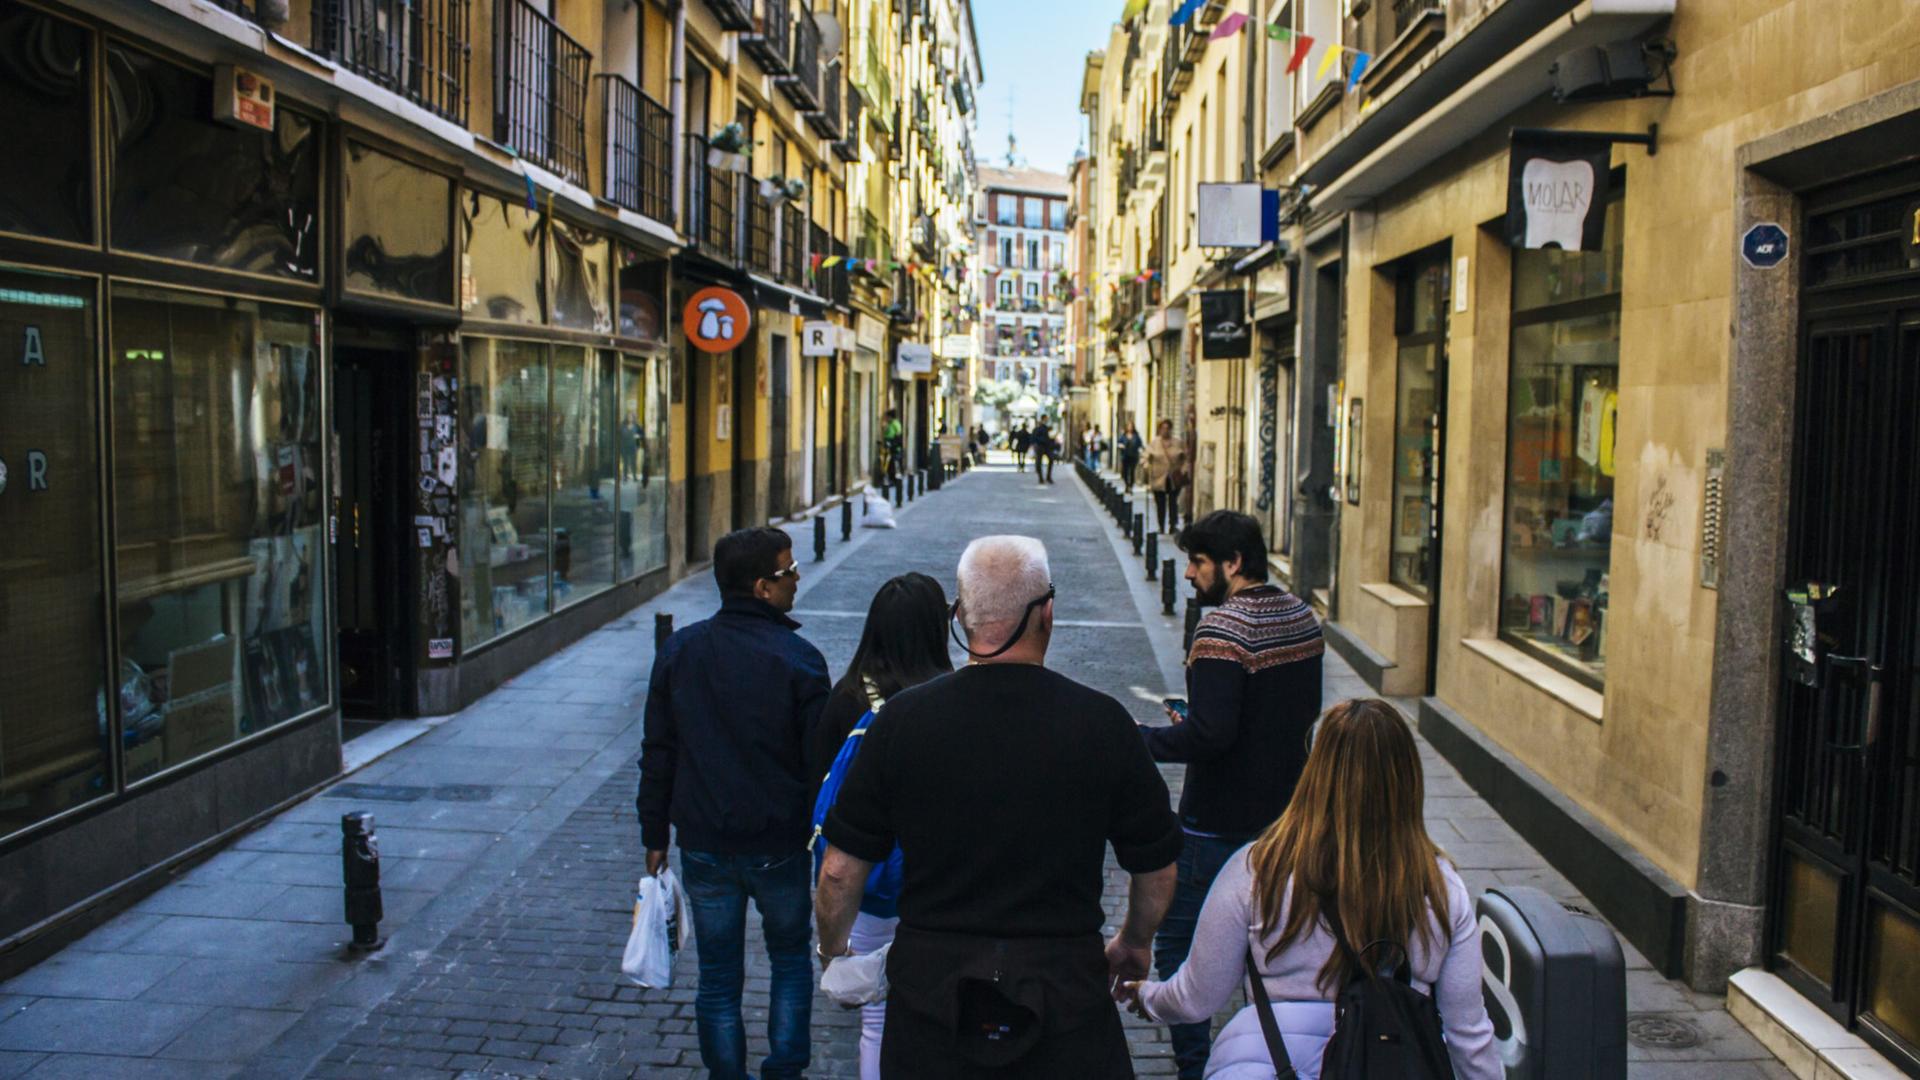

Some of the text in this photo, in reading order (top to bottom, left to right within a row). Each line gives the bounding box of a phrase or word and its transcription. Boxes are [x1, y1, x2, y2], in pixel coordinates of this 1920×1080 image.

[1528, 181, 1586, 209] MOLAR
[23, 325, 45, 366] A
[812, 329, 825, 346] R
[28, 450, 48, 491] R
